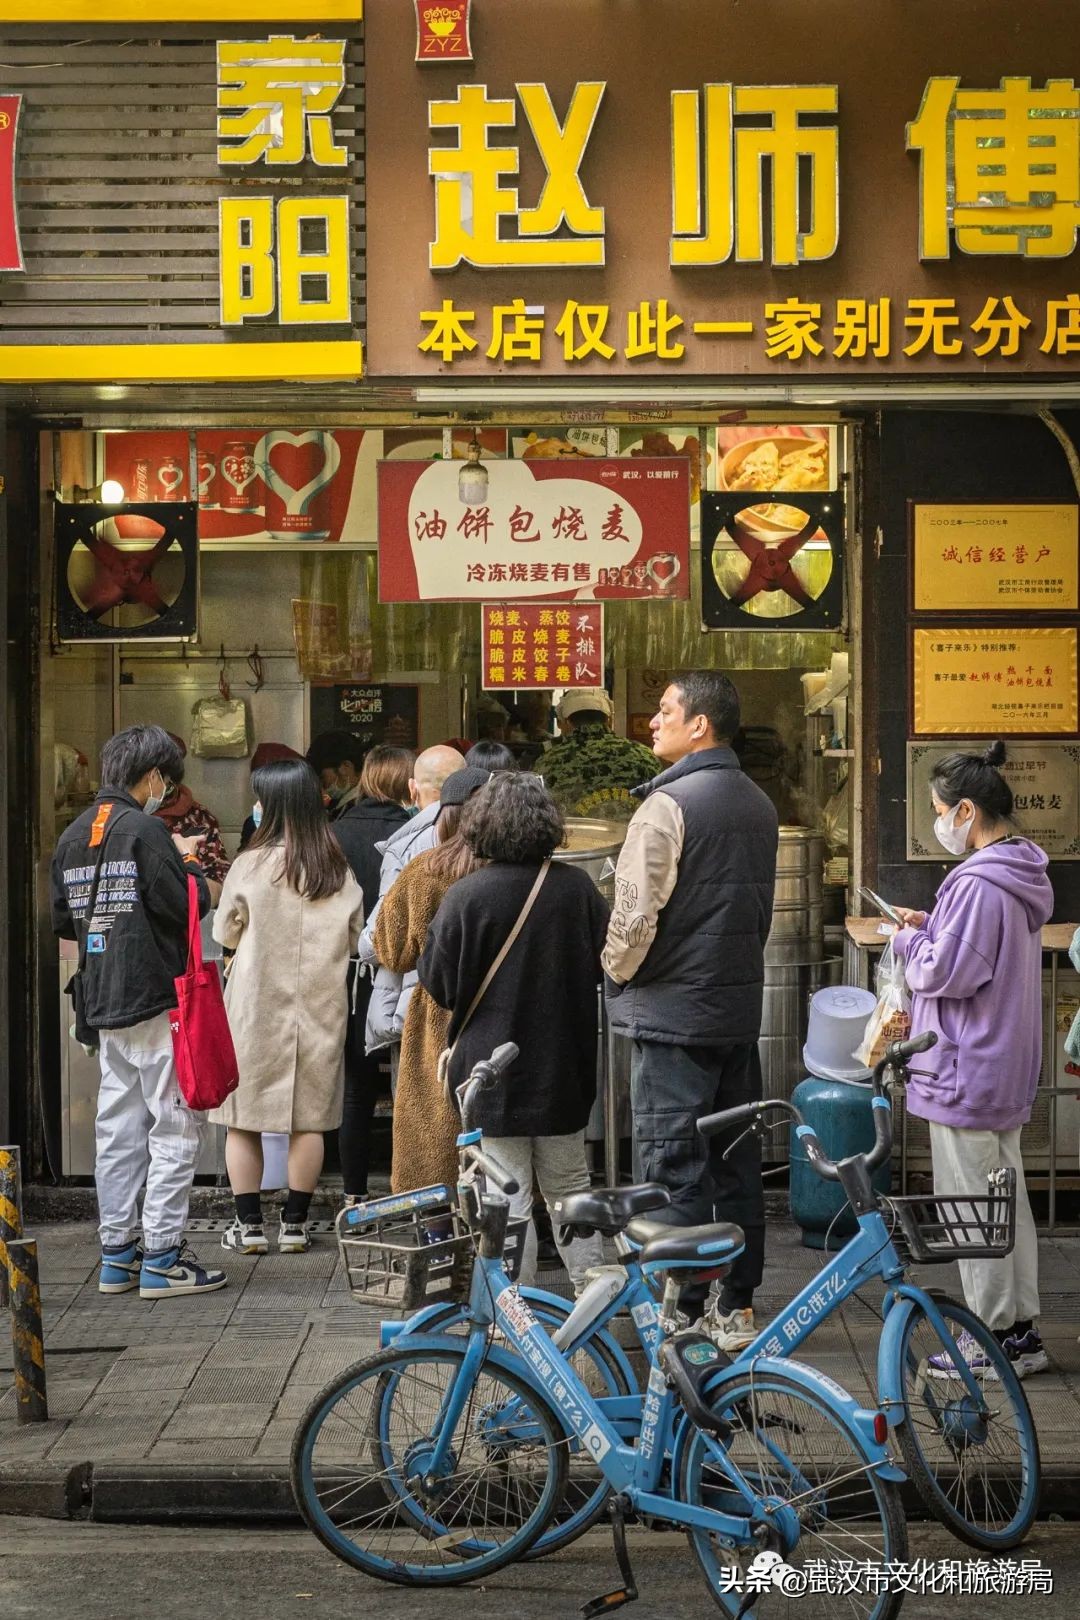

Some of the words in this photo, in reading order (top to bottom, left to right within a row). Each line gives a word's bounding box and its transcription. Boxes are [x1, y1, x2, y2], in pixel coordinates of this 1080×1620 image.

[424, 37, 463, 53] ZYZ
[428, 75, 1080, 269] 赵师傅
[417, 294, 1080, 363] 本店仅此一家别无分店
[414, 503, 631, 543] 油饼包烧麦
[941, 544, 1051, 564] 诚信经营户
[466, 562, 592, 583] 冷冻烧麦有售
[489, 629, 571, 645] 脆皮烧麦
[574, 614, 597, 680] 不排队
[489, 647, 571, 665] 脆皮饺子
[489, 665, 571, 683] 糯米春卷
[350, 713, 373, 723] 2020
